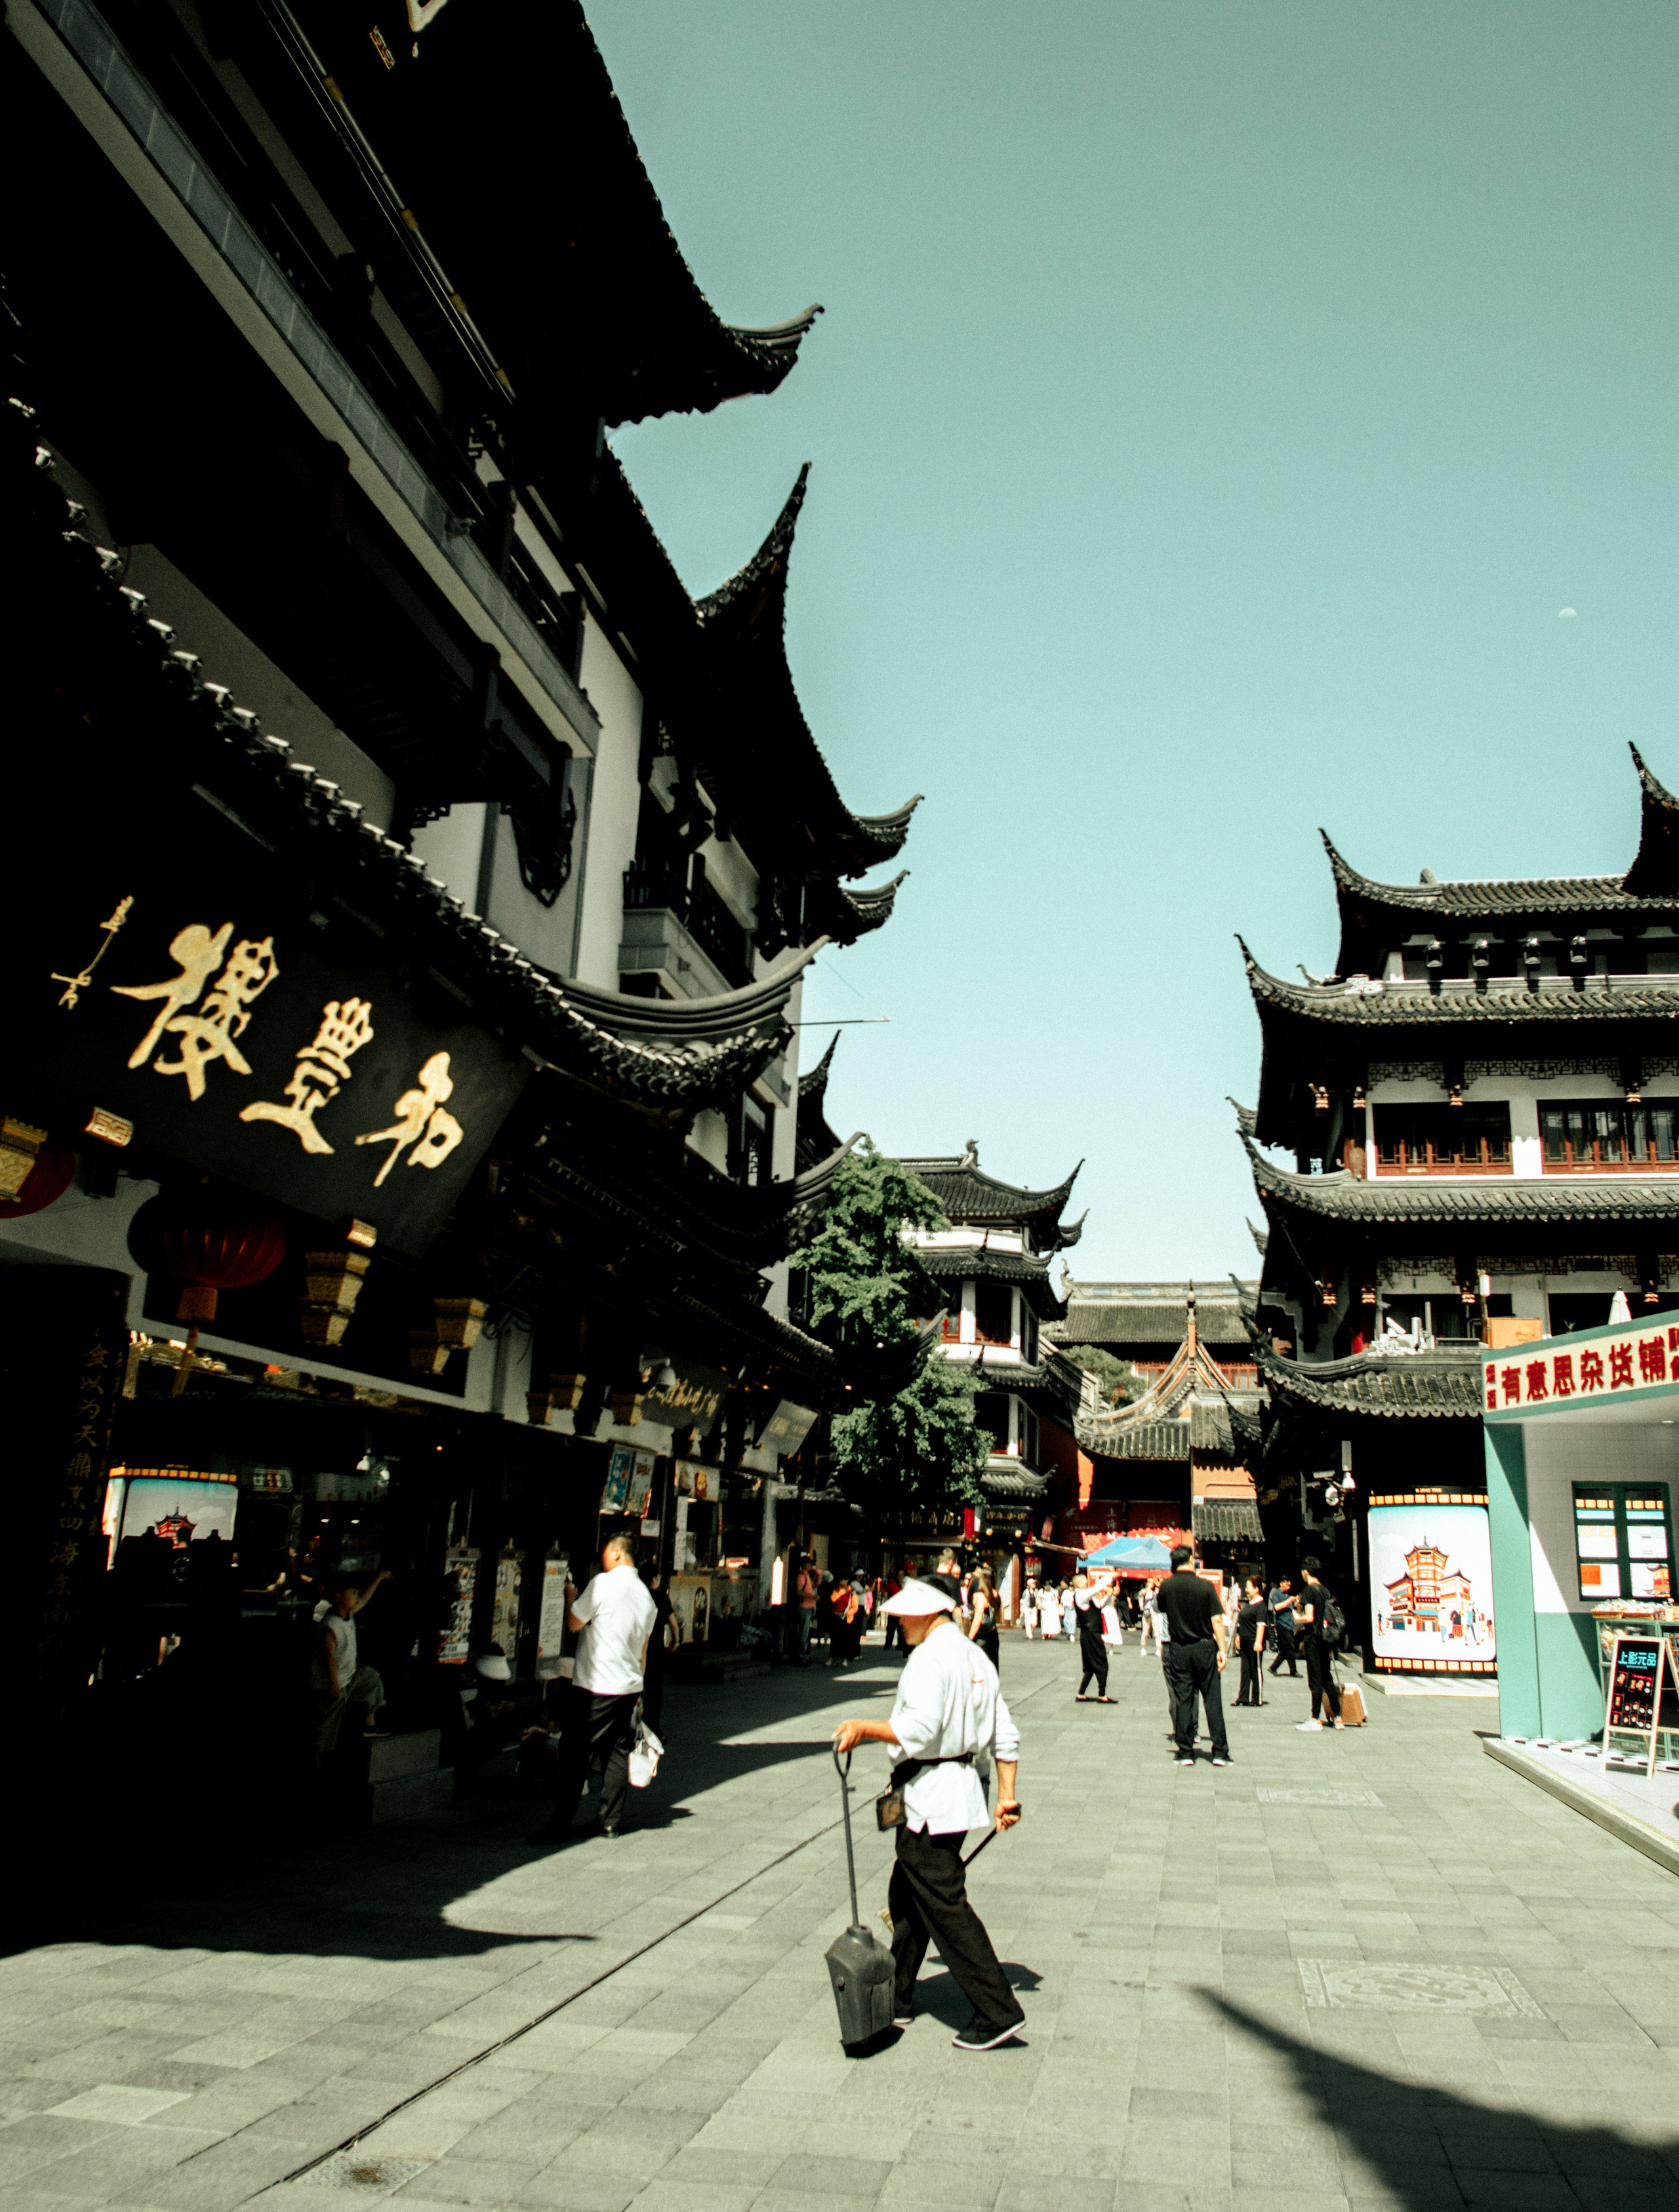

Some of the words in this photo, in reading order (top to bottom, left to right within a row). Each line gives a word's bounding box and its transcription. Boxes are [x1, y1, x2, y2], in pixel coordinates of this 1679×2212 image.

[1501, 1335, 1667, 1405] 有意思杂货铺
[1617, 1651, 1657, 1666] 上影元品
